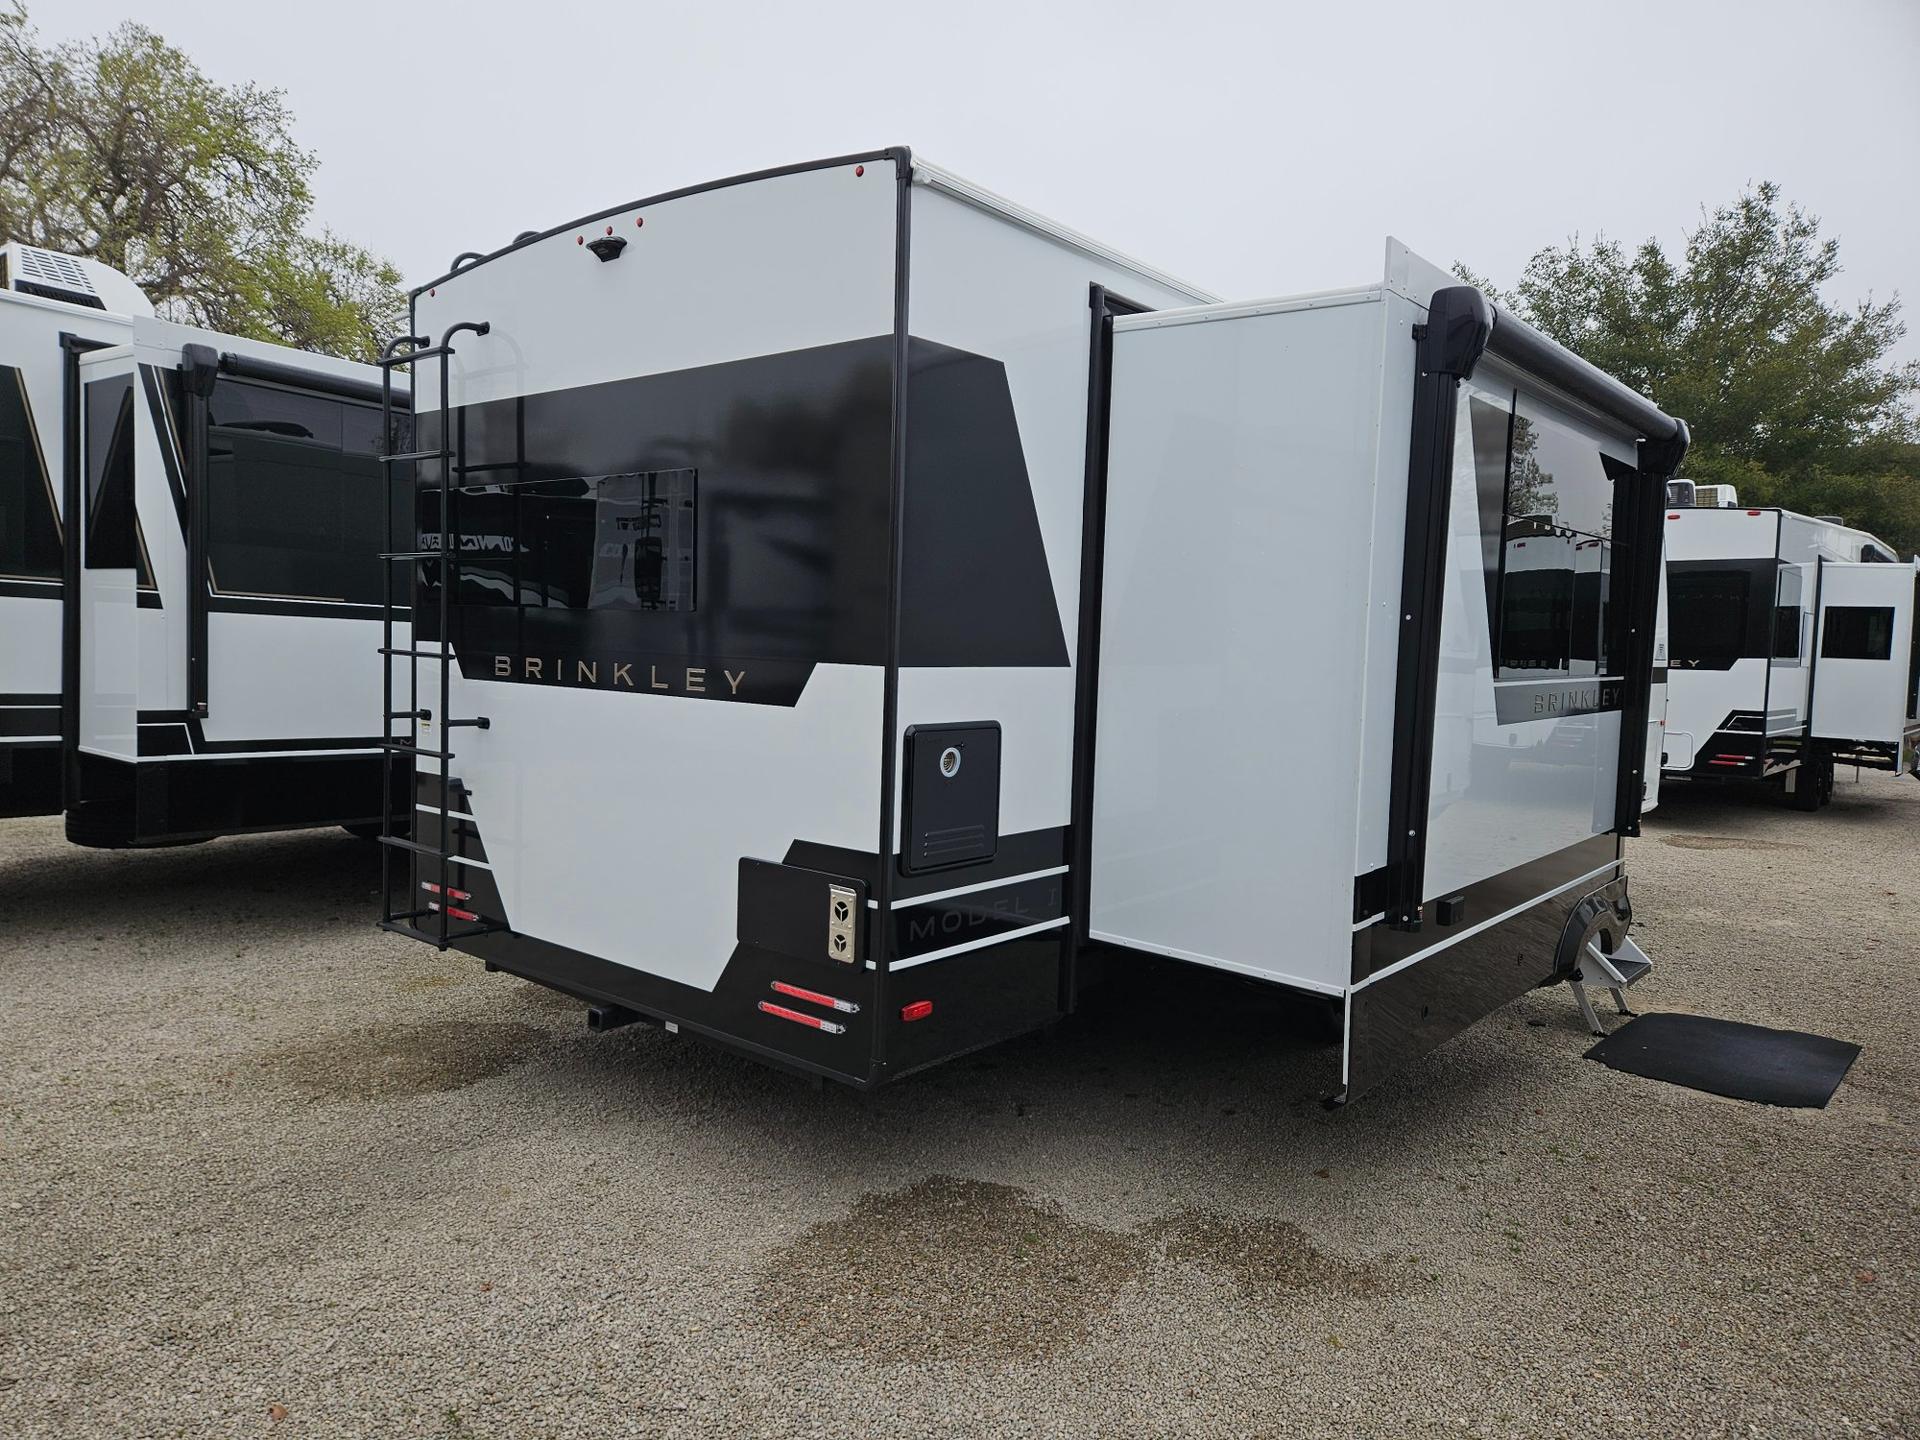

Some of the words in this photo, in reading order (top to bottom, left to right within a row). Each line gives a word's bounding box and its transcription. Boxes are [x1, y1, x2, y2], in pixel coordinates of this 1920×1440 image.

[494, 655, 747, 695] BRINKLEY
[1534, 687, 1621, 715] BRINKLEY
[908, 895, 1030, 942] MODEL
